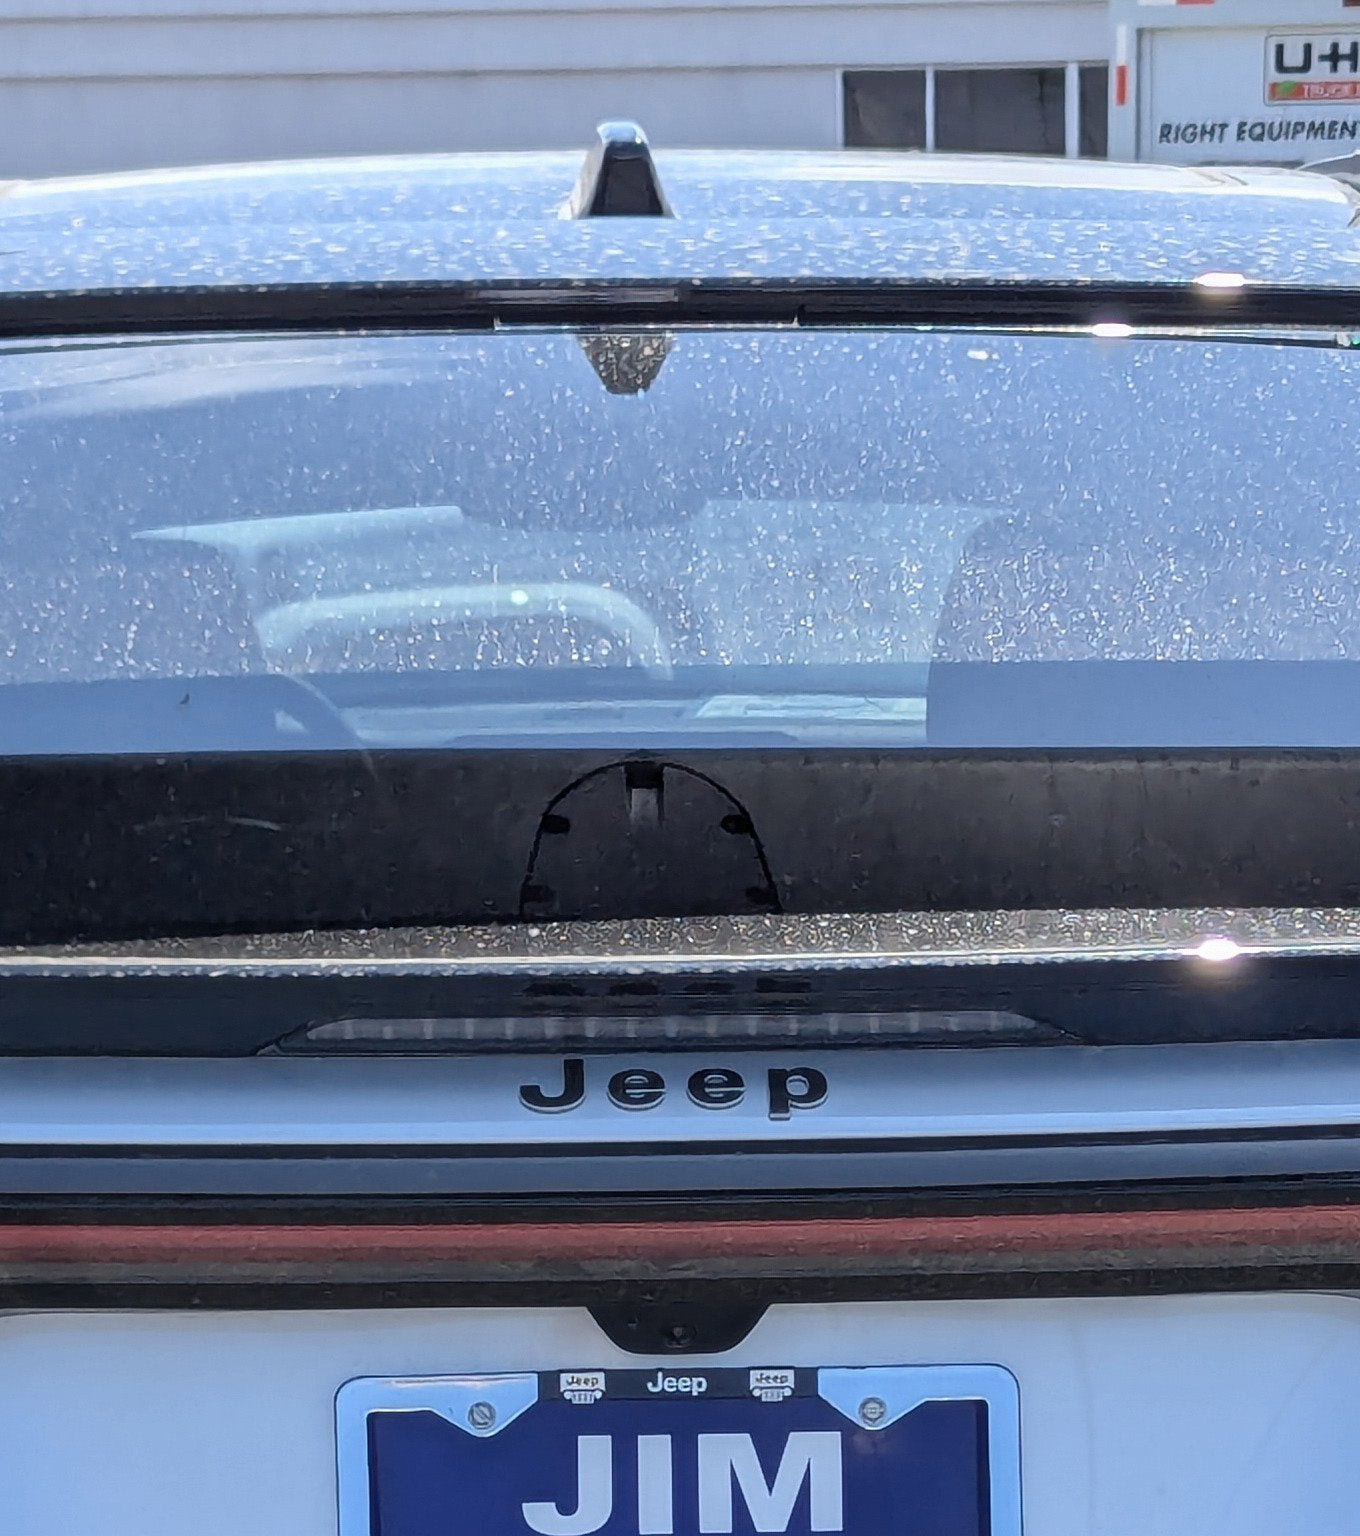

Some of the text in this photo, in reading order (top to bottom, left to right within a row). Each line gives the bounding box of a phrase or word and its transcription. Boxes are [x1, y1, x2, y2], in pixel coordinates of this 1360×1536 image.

[1158, 122, 1229, 144] RIGHT
[519, 1058, 829, 1121] Jeep
[566, 1374, 600, 1388] Jeep
[646, 1371, 708, 1396] Jeep
[755, 1372, 789, 1385] Jeep
[521, 1430, 844, 1536] JIM
